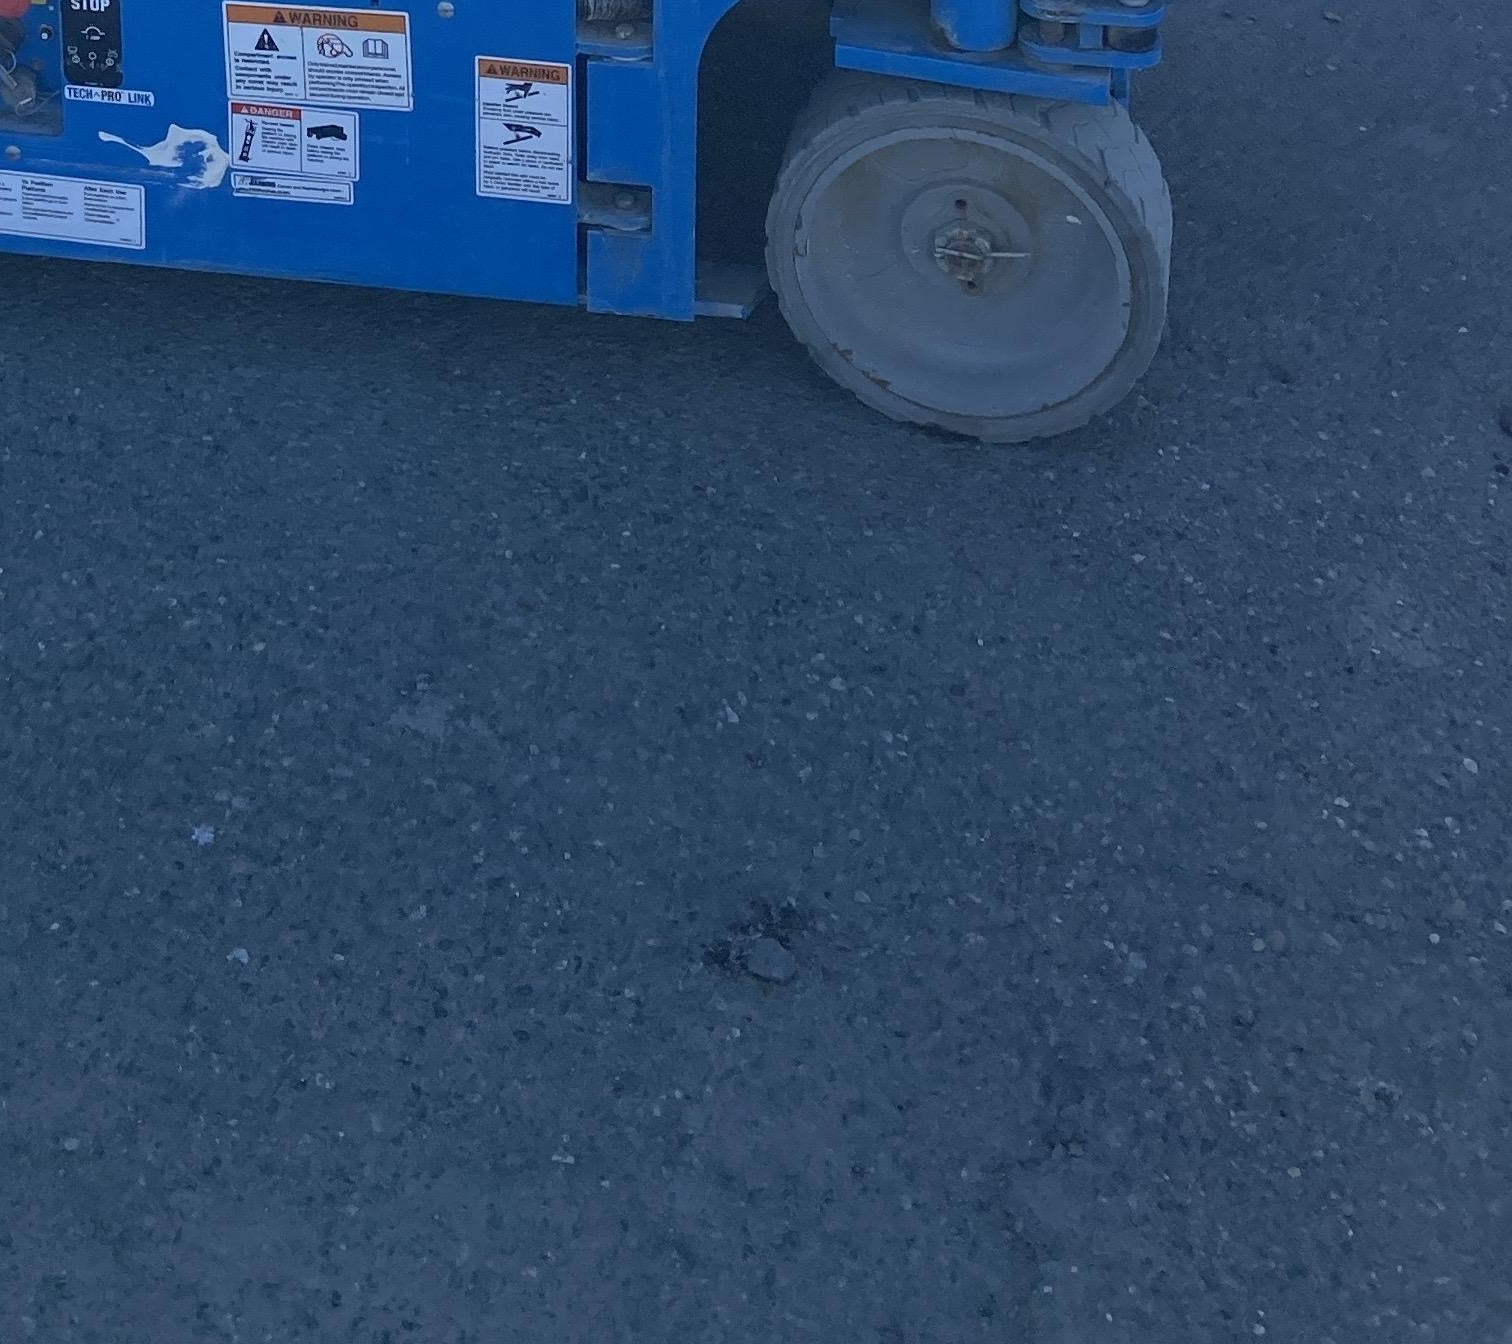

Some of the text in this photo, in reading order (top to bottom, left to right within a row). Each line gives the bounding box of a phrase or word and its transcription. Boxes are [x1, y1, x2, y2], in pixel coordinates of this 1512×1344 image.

[289, 12, 359, 29] WARNING
[499, 64, 561, 81] WARNING
[128, 91, 152, 104] LINK
[249, 106, 293, 119] DANGER
